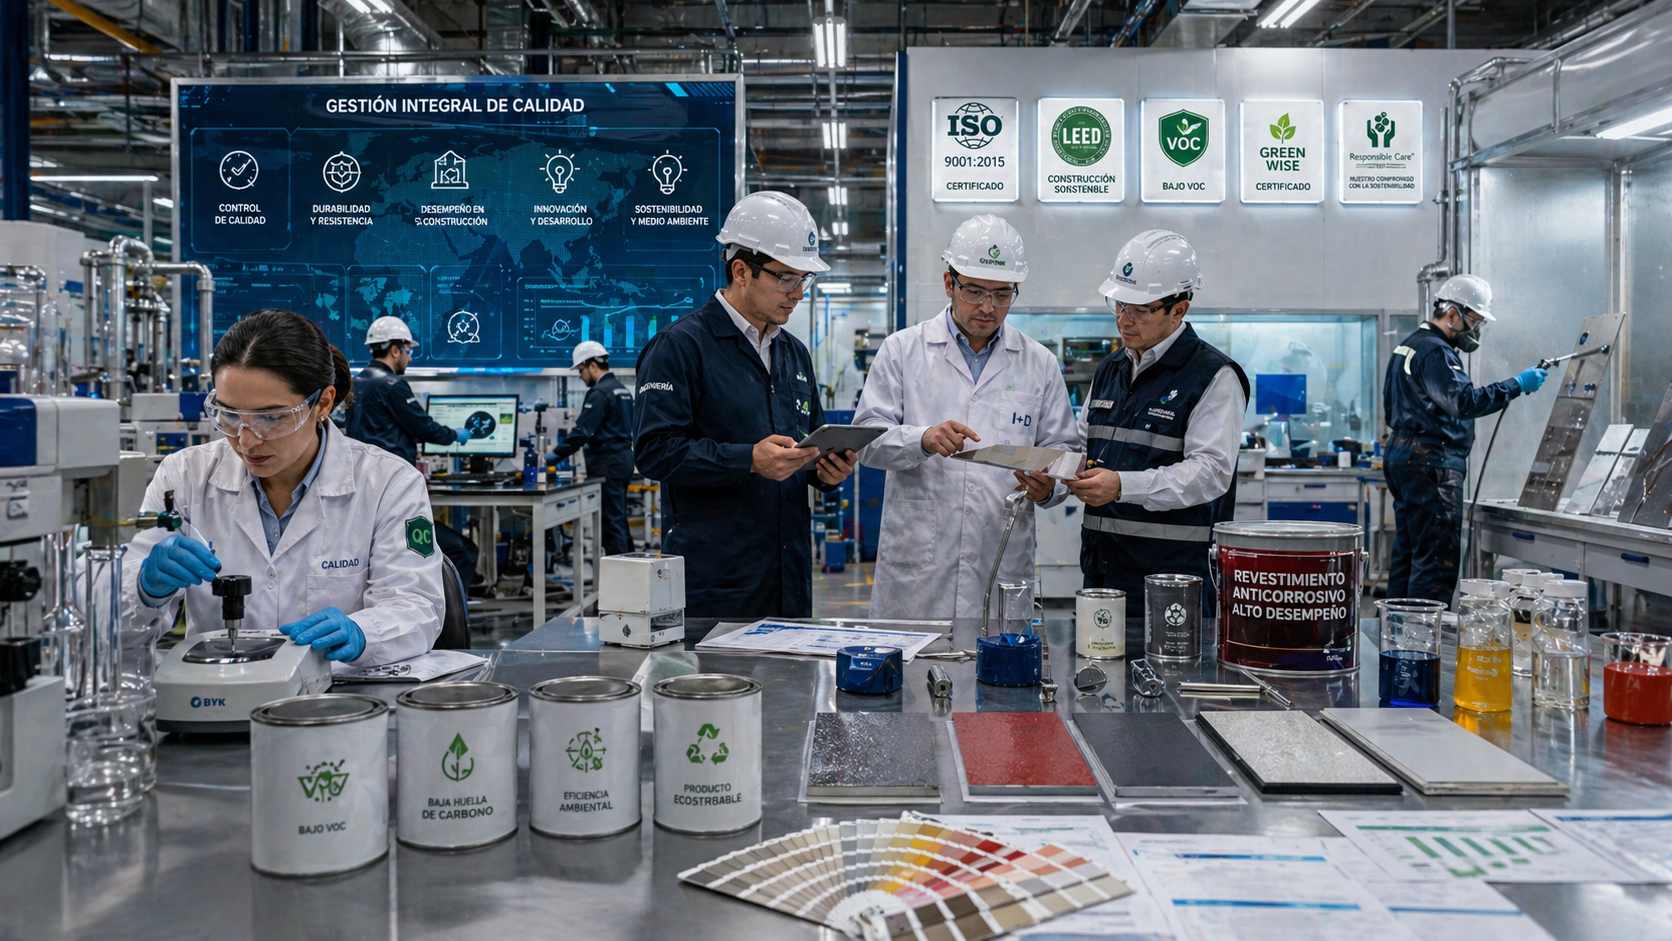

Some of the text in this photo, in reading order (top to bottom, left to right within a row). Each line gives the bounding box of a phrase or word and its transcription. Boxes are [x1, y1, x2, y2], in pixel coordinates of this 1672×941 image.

[326, 95, 585, 113] GESTIÓN INTEGRAL DE CALIDAD
[947, 115, 1003, 137] ISO
[1062, 127, 1101, 145] LEED
[1166, 136, 1201, 151] VOC
[1259, 147, 1306, 159] GREEN
[1349, 153, 1393, 163] Responsible
[944, 156, 1005, 168] 9001:2015
[1266, 160, 1300, 172] WISE
[1047, 173, 1116, 184] CONSTRUCCIÓN
[946, 182, 1004, 191] CERTIFICADO
[1162, 182, 1206, 191] BAJO VOC
[1256, 182, 1311, 191] CERTIFICADO
[218, 203, 262, 213] CONTROL
[312, 204, 371, 213] DURABILIDAD
[420, 203, 472, 214] DESEMPEÑO
[533, 203, 588, 213] INNOVACIÓN
[635, 204, 703, 214] SOSTENIBILIDAD
[214, 216, 266, 225] DE CALIDAD
[310, 216, 373, 225] Y RESISTENCIA
[530, 217, 593, 226] Y DESARROLLO
[630, 217, 709, 226] Y MEDIO AMBIENTE
[1011, 411, 1032, 427] I+D
[411, 528, 432, 545] QC
[321, 557, 360, 570] CALIDAD
[1233, 569, 1346, 587] REVESTIMIENTO
[1232, 586, 1346, 604] ANTICORROSIVO
[1231, 602, 1347, 621] ALTO DESEMPEÑO
[203, 697, 225, 707] BYK
[683, 782, 732, 794] PRODUCTO
[427, 795, 488, 807] BAJA HUELLA
[563, 789, 609, 801] EFICIENCIA
[559, 800, 614, 813] AMBIENTAL
[422, 806, 494, 820] DE CARBONO
[298, 821, 347, 835] BAJO VOC
